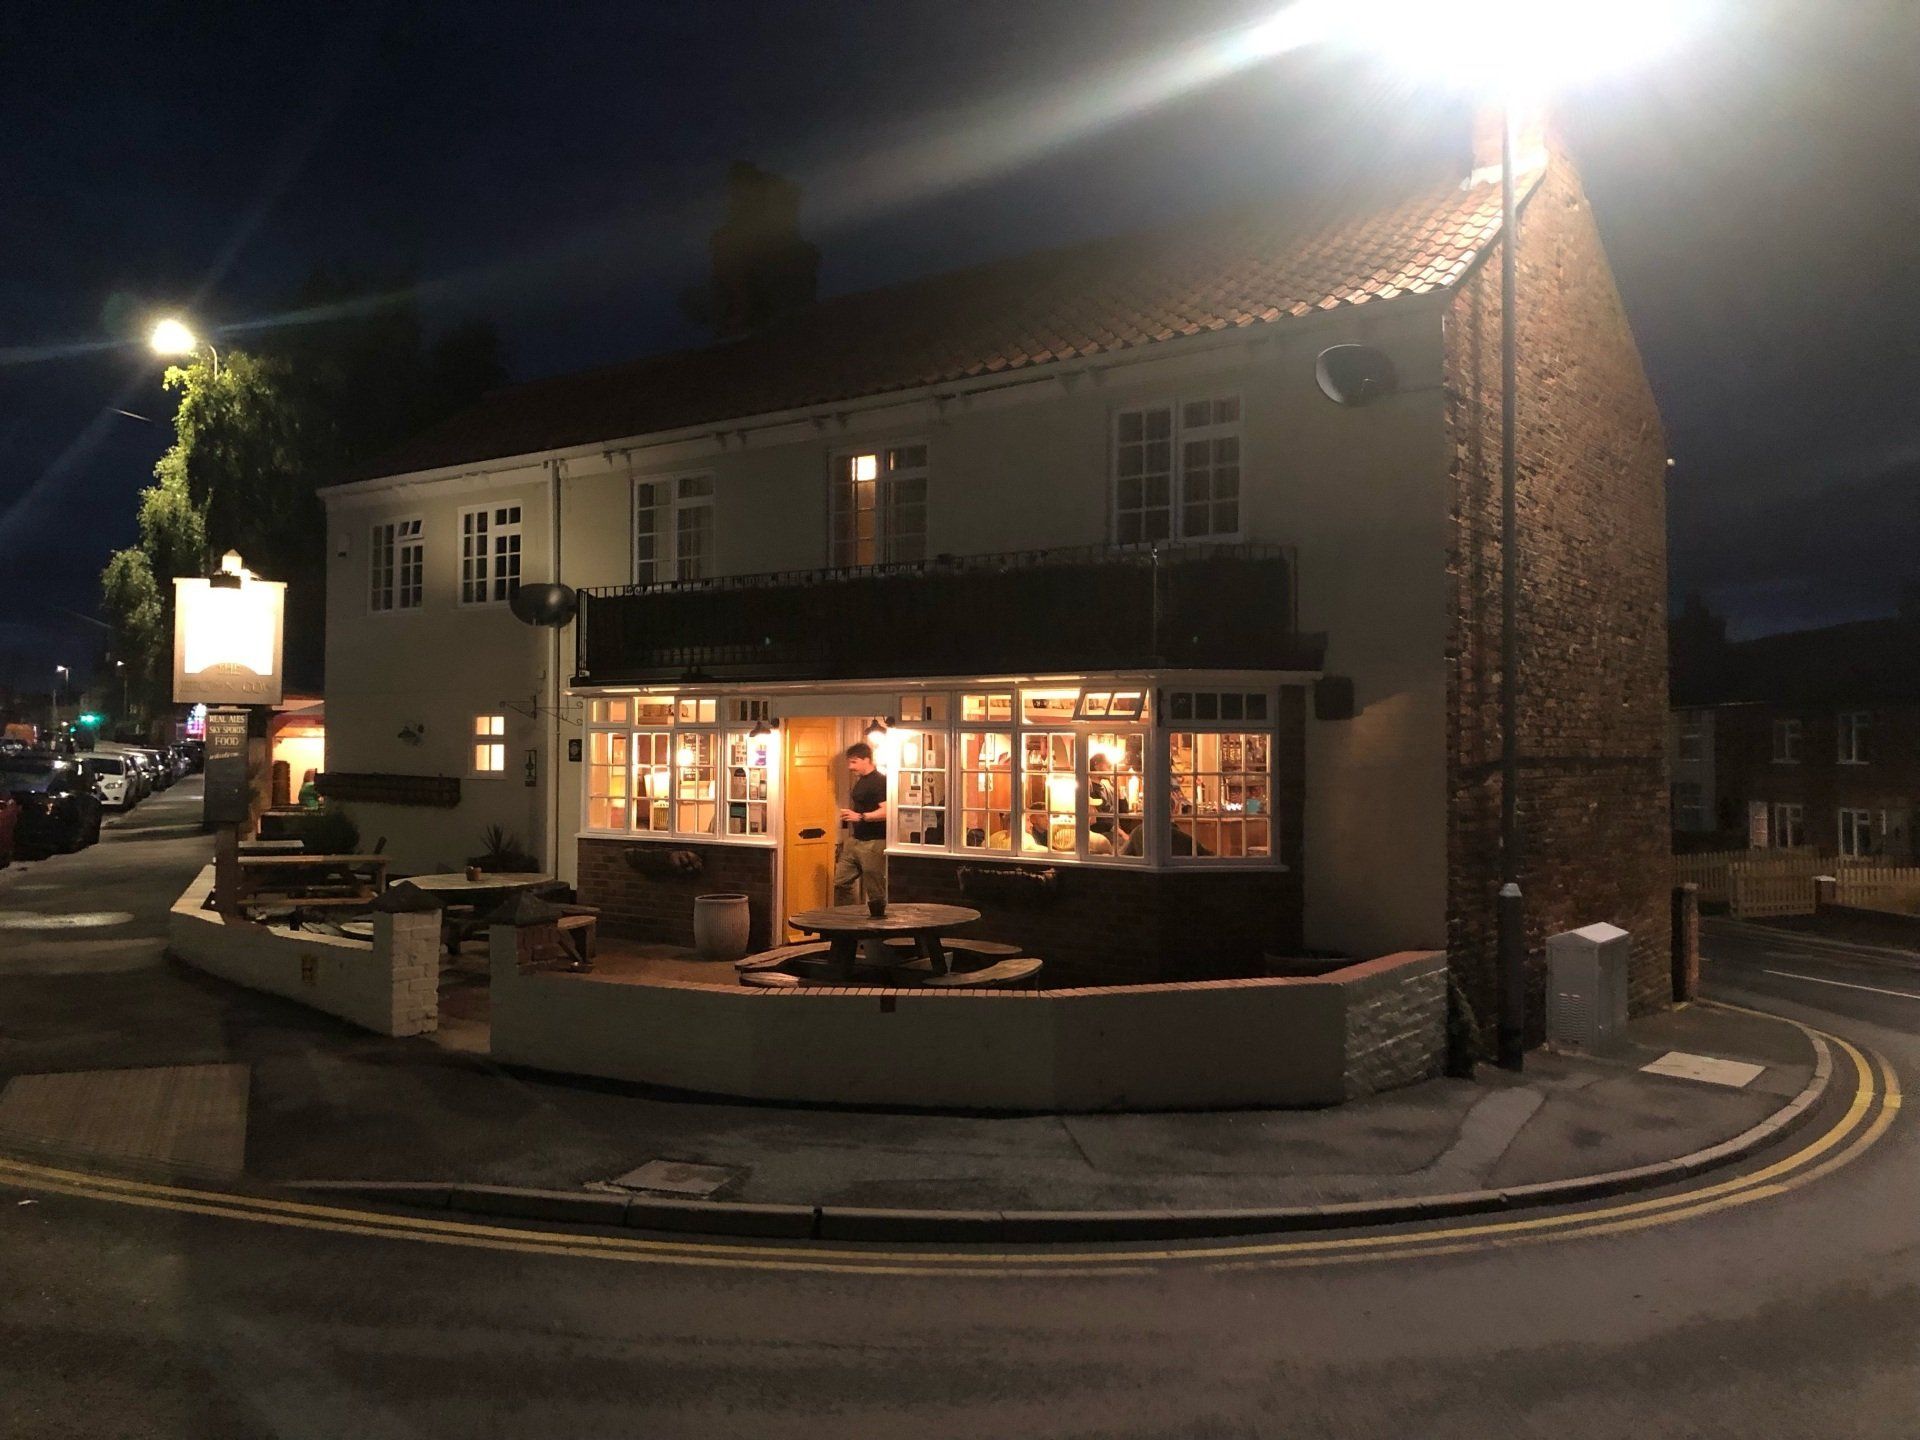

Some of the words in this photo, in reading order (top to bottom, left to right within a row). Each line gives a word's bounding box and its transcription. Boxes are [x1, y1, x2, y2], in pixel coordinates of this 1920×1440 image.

[209, 715, 226, 723] REAL
[229, 715, 245, 723] ALES
[209, 726, 221, 734] SKY
[223, 726, 246, 734] SPORTS
[215, 737, 240, 746] FOOD
